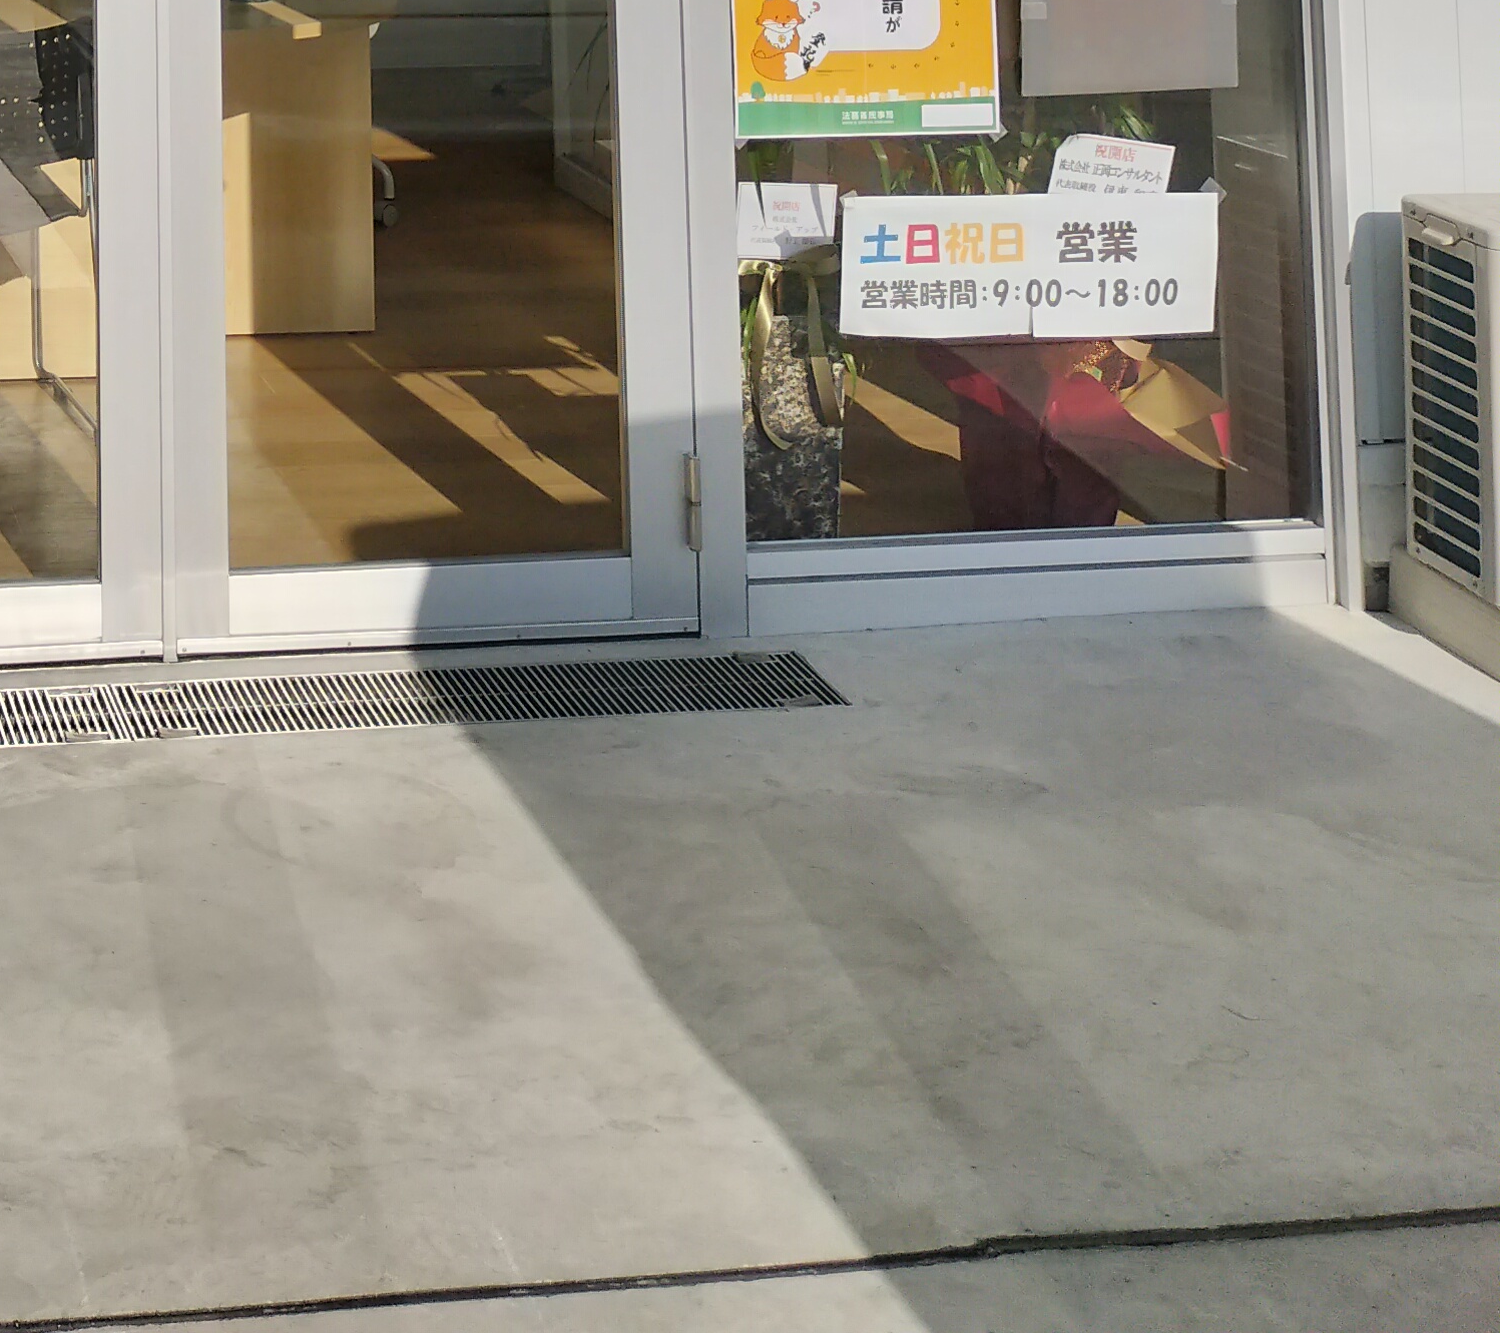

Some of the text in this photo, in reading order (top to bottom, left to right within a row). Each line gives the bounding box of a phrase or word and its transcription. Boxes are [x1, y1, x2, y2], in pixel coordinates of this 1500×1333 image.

[860, 221, 1138, 265] 土日祝日 営業
